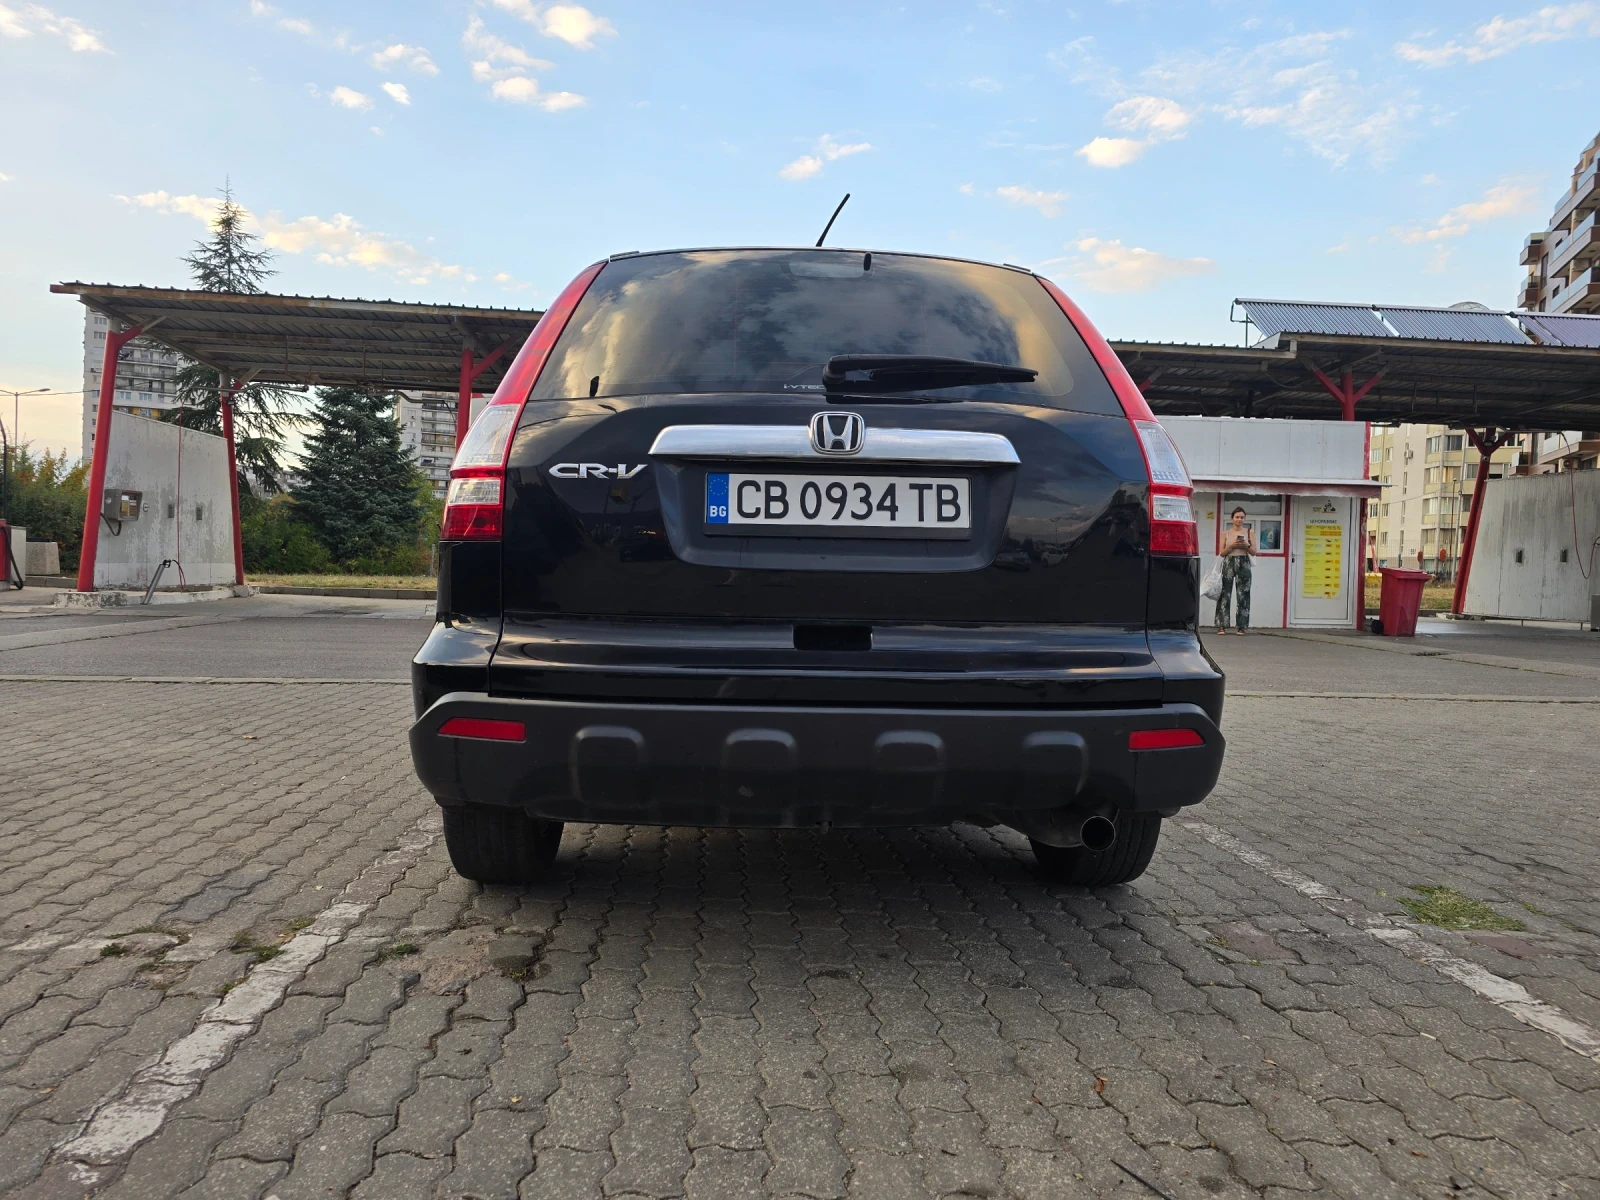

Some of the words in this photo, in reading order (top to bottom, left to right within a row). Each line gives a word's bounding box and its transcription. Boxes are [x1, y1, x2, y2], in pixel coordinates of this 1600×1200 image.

[549, 462, 648, 479] CR-V
[736, 479, 790, 520] CB
[800, 481, 899, 522] 0934
[909, 483, 961, 522] TB
[709, 505, 727, 518] BG
